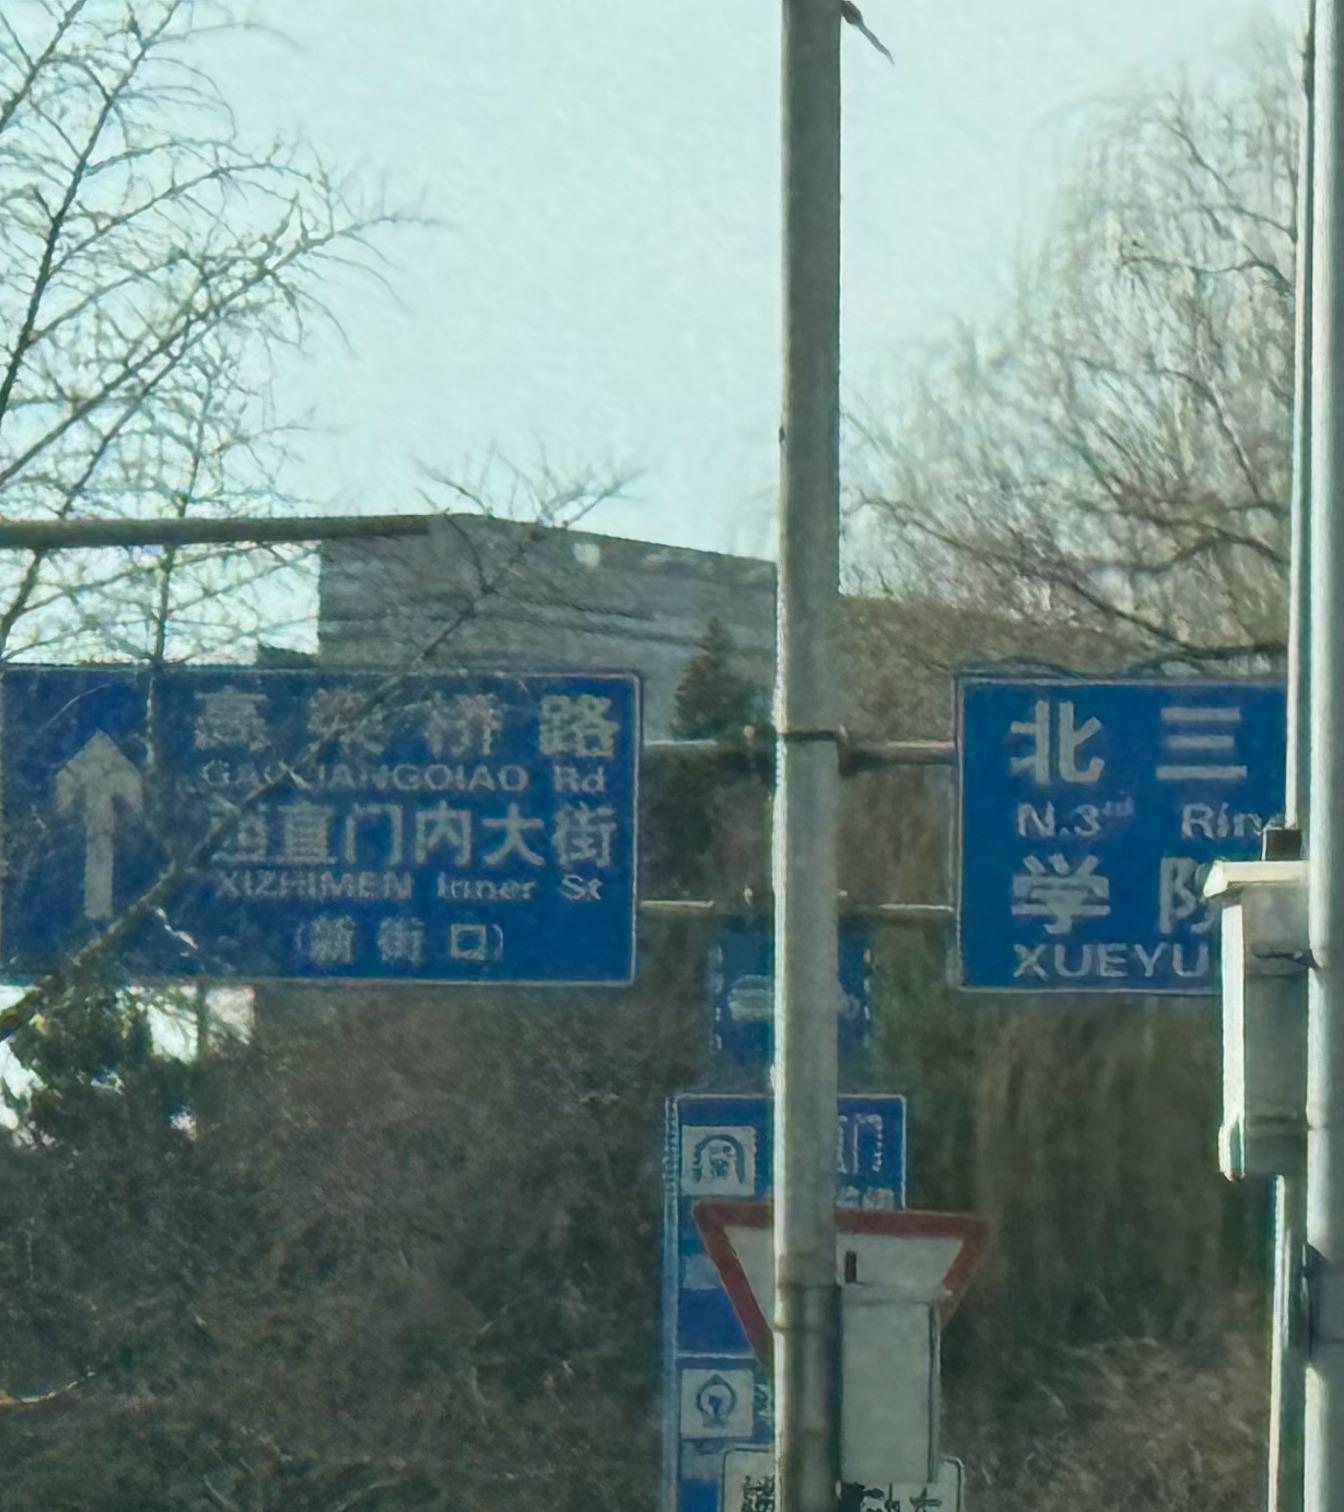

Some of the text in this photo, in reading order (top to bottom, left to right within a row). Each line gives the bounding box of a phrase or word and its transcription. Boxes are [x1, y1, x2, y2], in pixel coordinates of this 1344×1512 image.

[553, 764, 606, 794] Rd
[213, 870, 413, 901] XIZHIMEN
[436, 872, 538, 900] Inner
